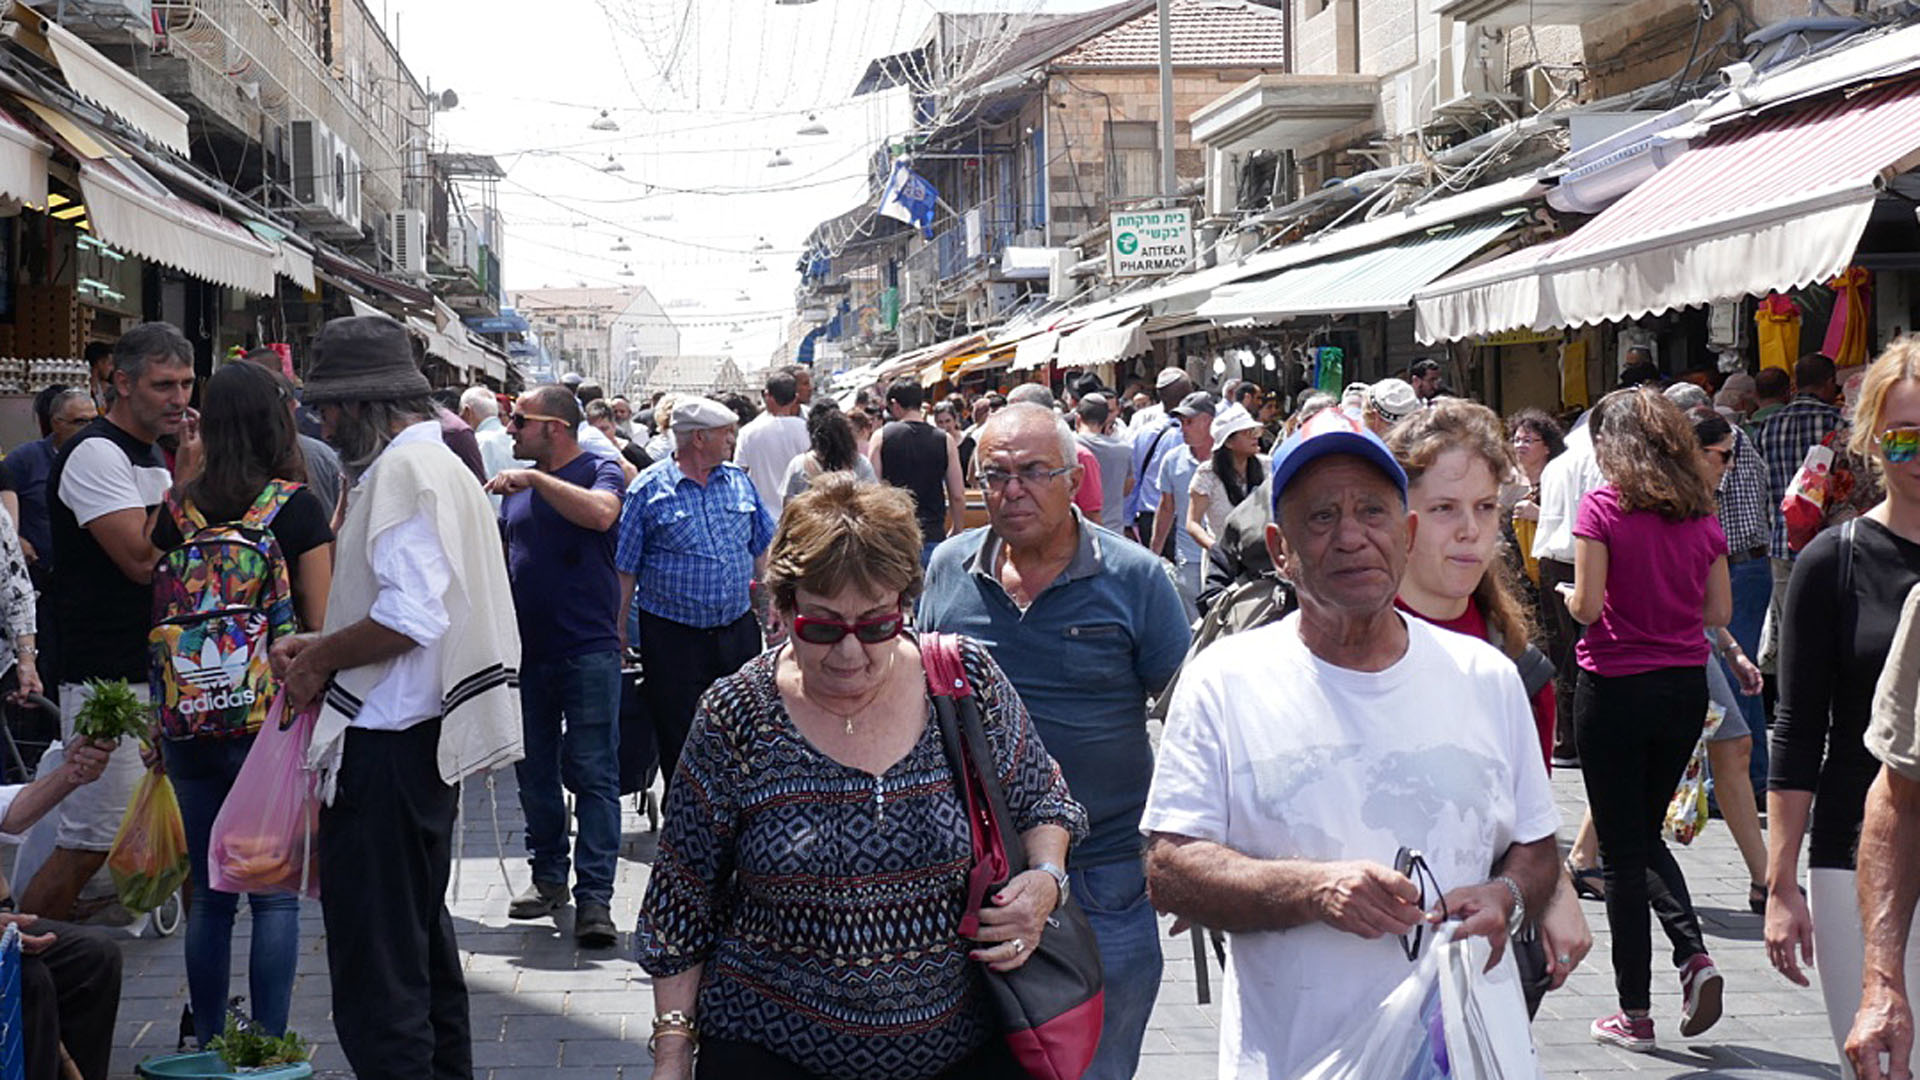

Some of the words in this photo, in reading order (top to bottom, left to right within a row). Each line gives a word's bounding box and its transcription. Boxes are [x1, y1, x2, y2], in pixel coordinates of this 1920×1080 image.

[1117, 215, 1160, 228] מרקחת
[1164, 213, 1185, 223] בית
[1141, 245, 1186, 256] АПТЕКА
[1120, 258, 1187, 271] PHARMACY
[178, 689, 256, 714] adidas
